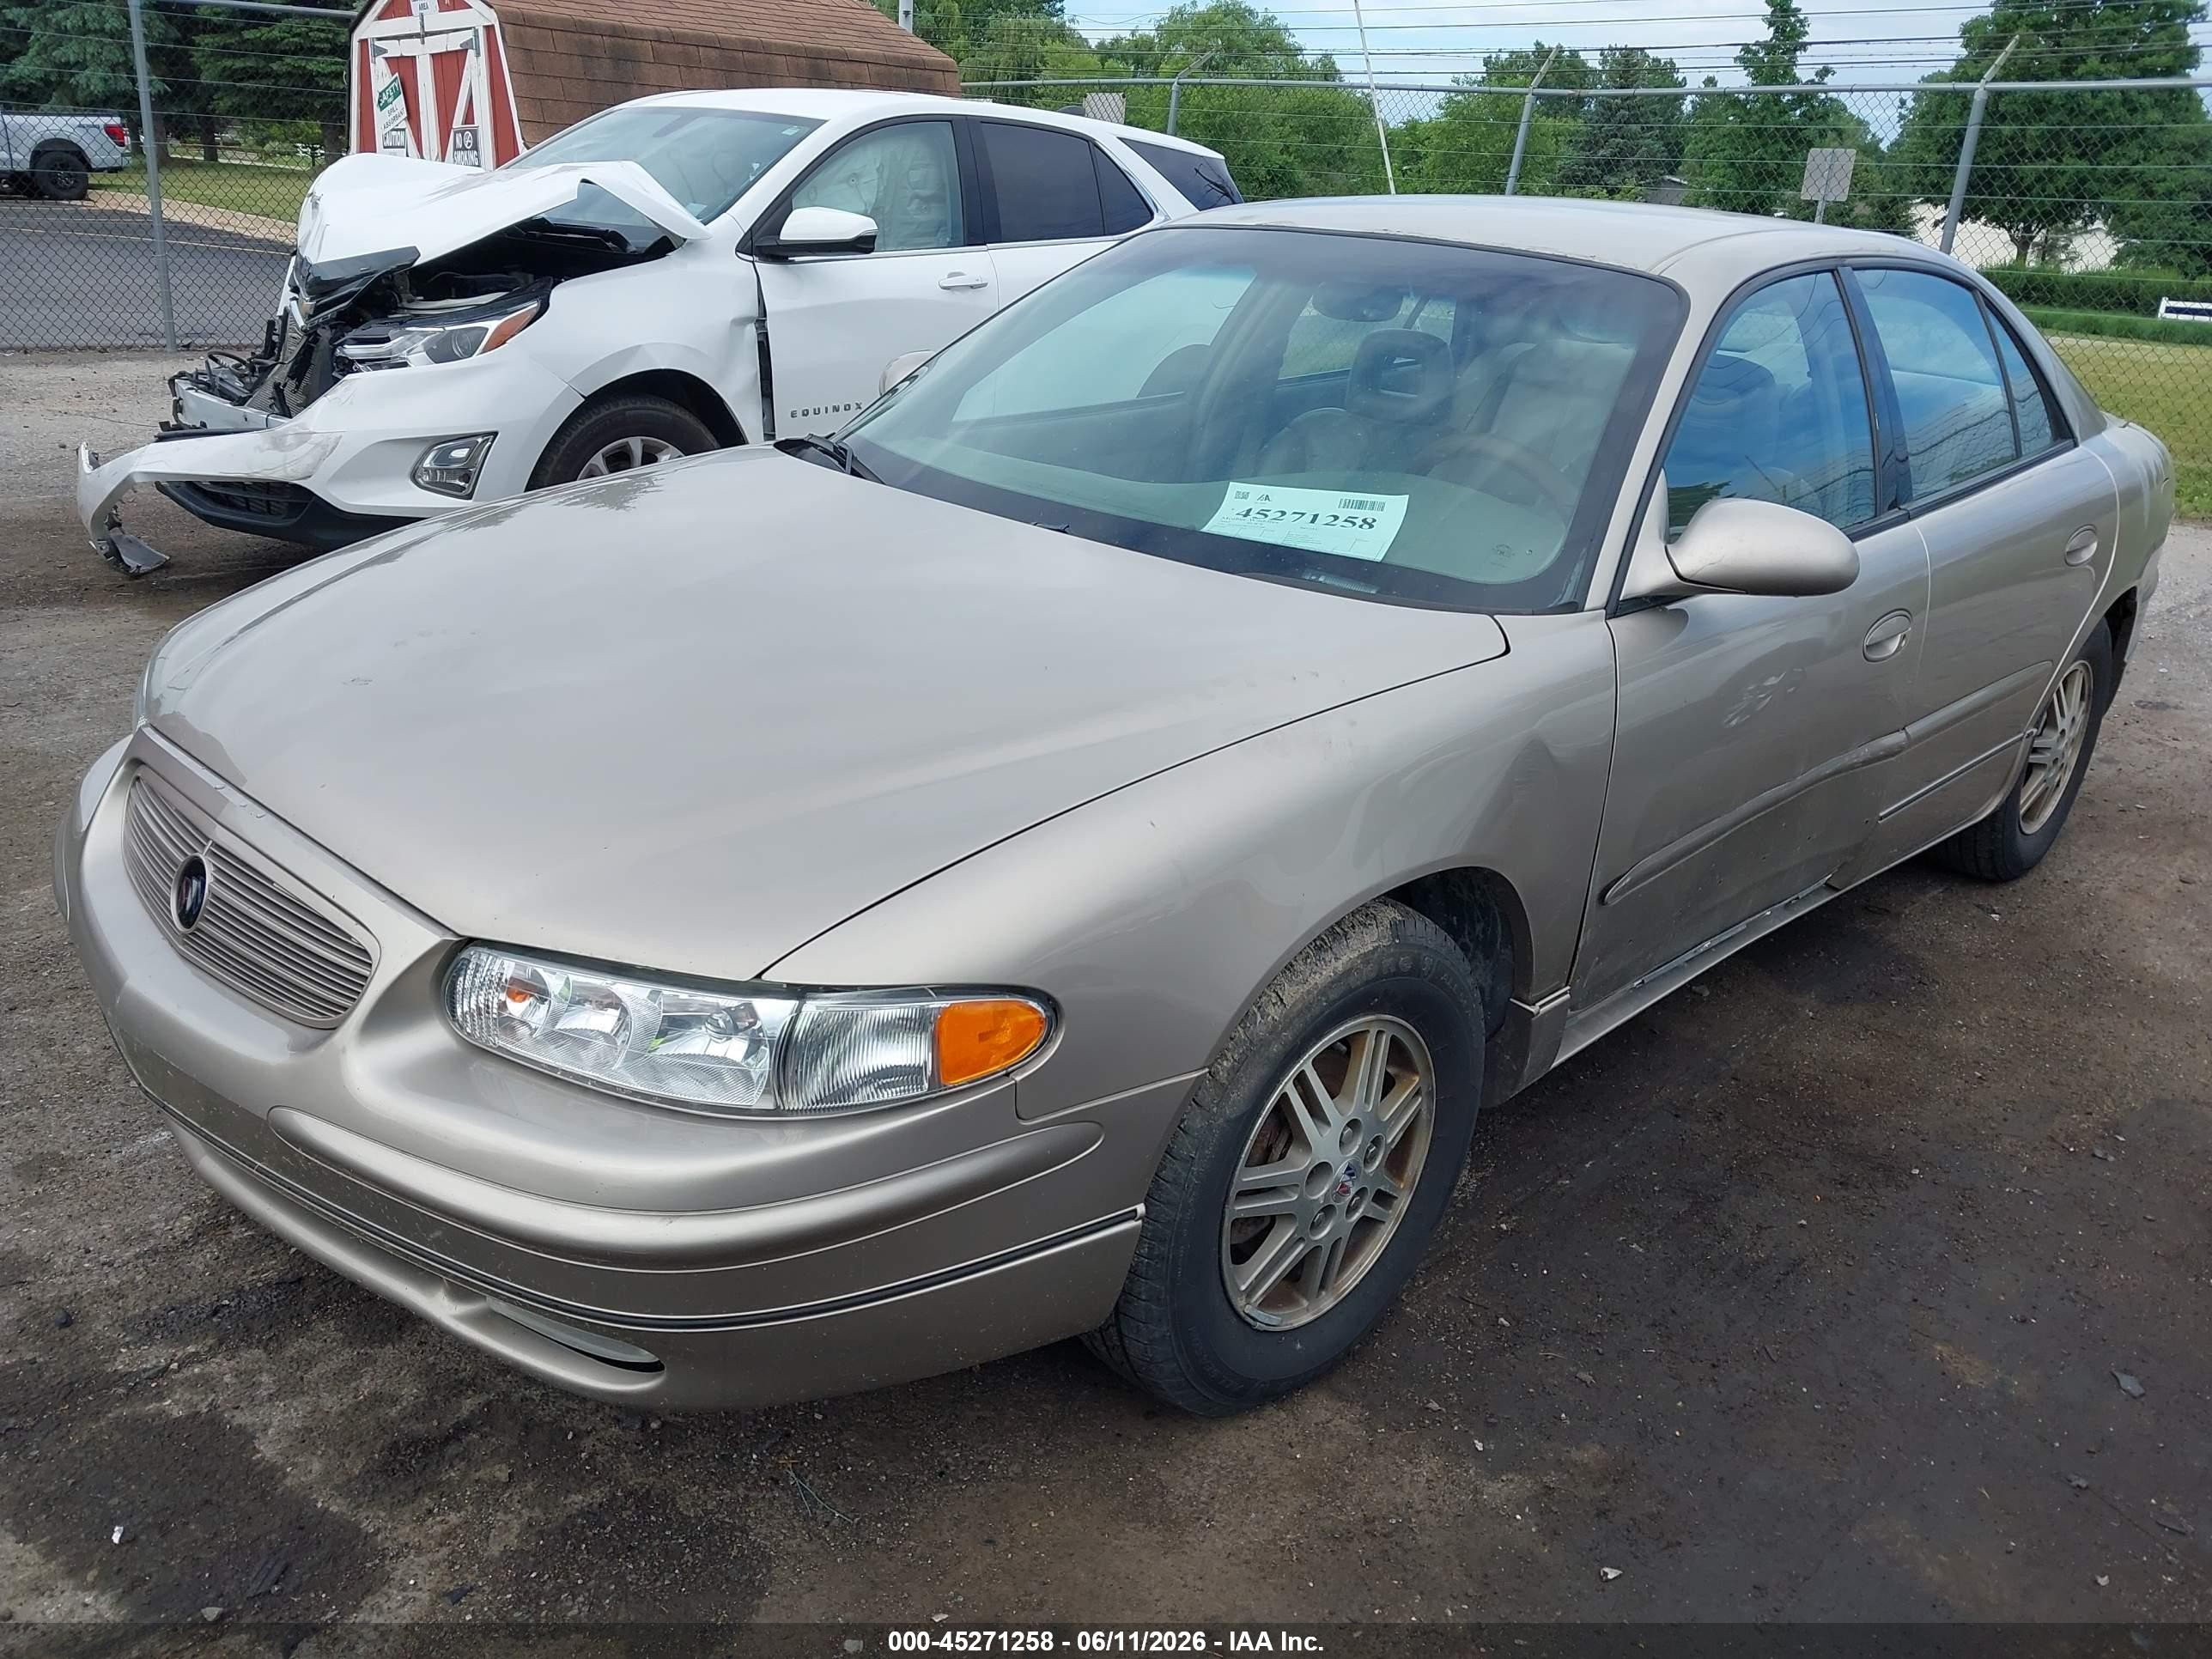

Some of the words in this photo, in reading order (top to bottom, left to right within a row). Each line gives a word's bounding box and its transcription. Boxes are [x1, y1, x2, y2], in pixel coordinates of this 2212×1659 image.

[379, 78, 400, 106] SAFETY
[387, 105, 398, 117] SPILL
[383, 131, 405, 146] CAUTION
[455, 132, 463, 149] NO
[453, 150, 478, 166] SMOKING
[791, 402, 862, 418] EQUINOX
[1236, 507, 1377, 530] 45271258
